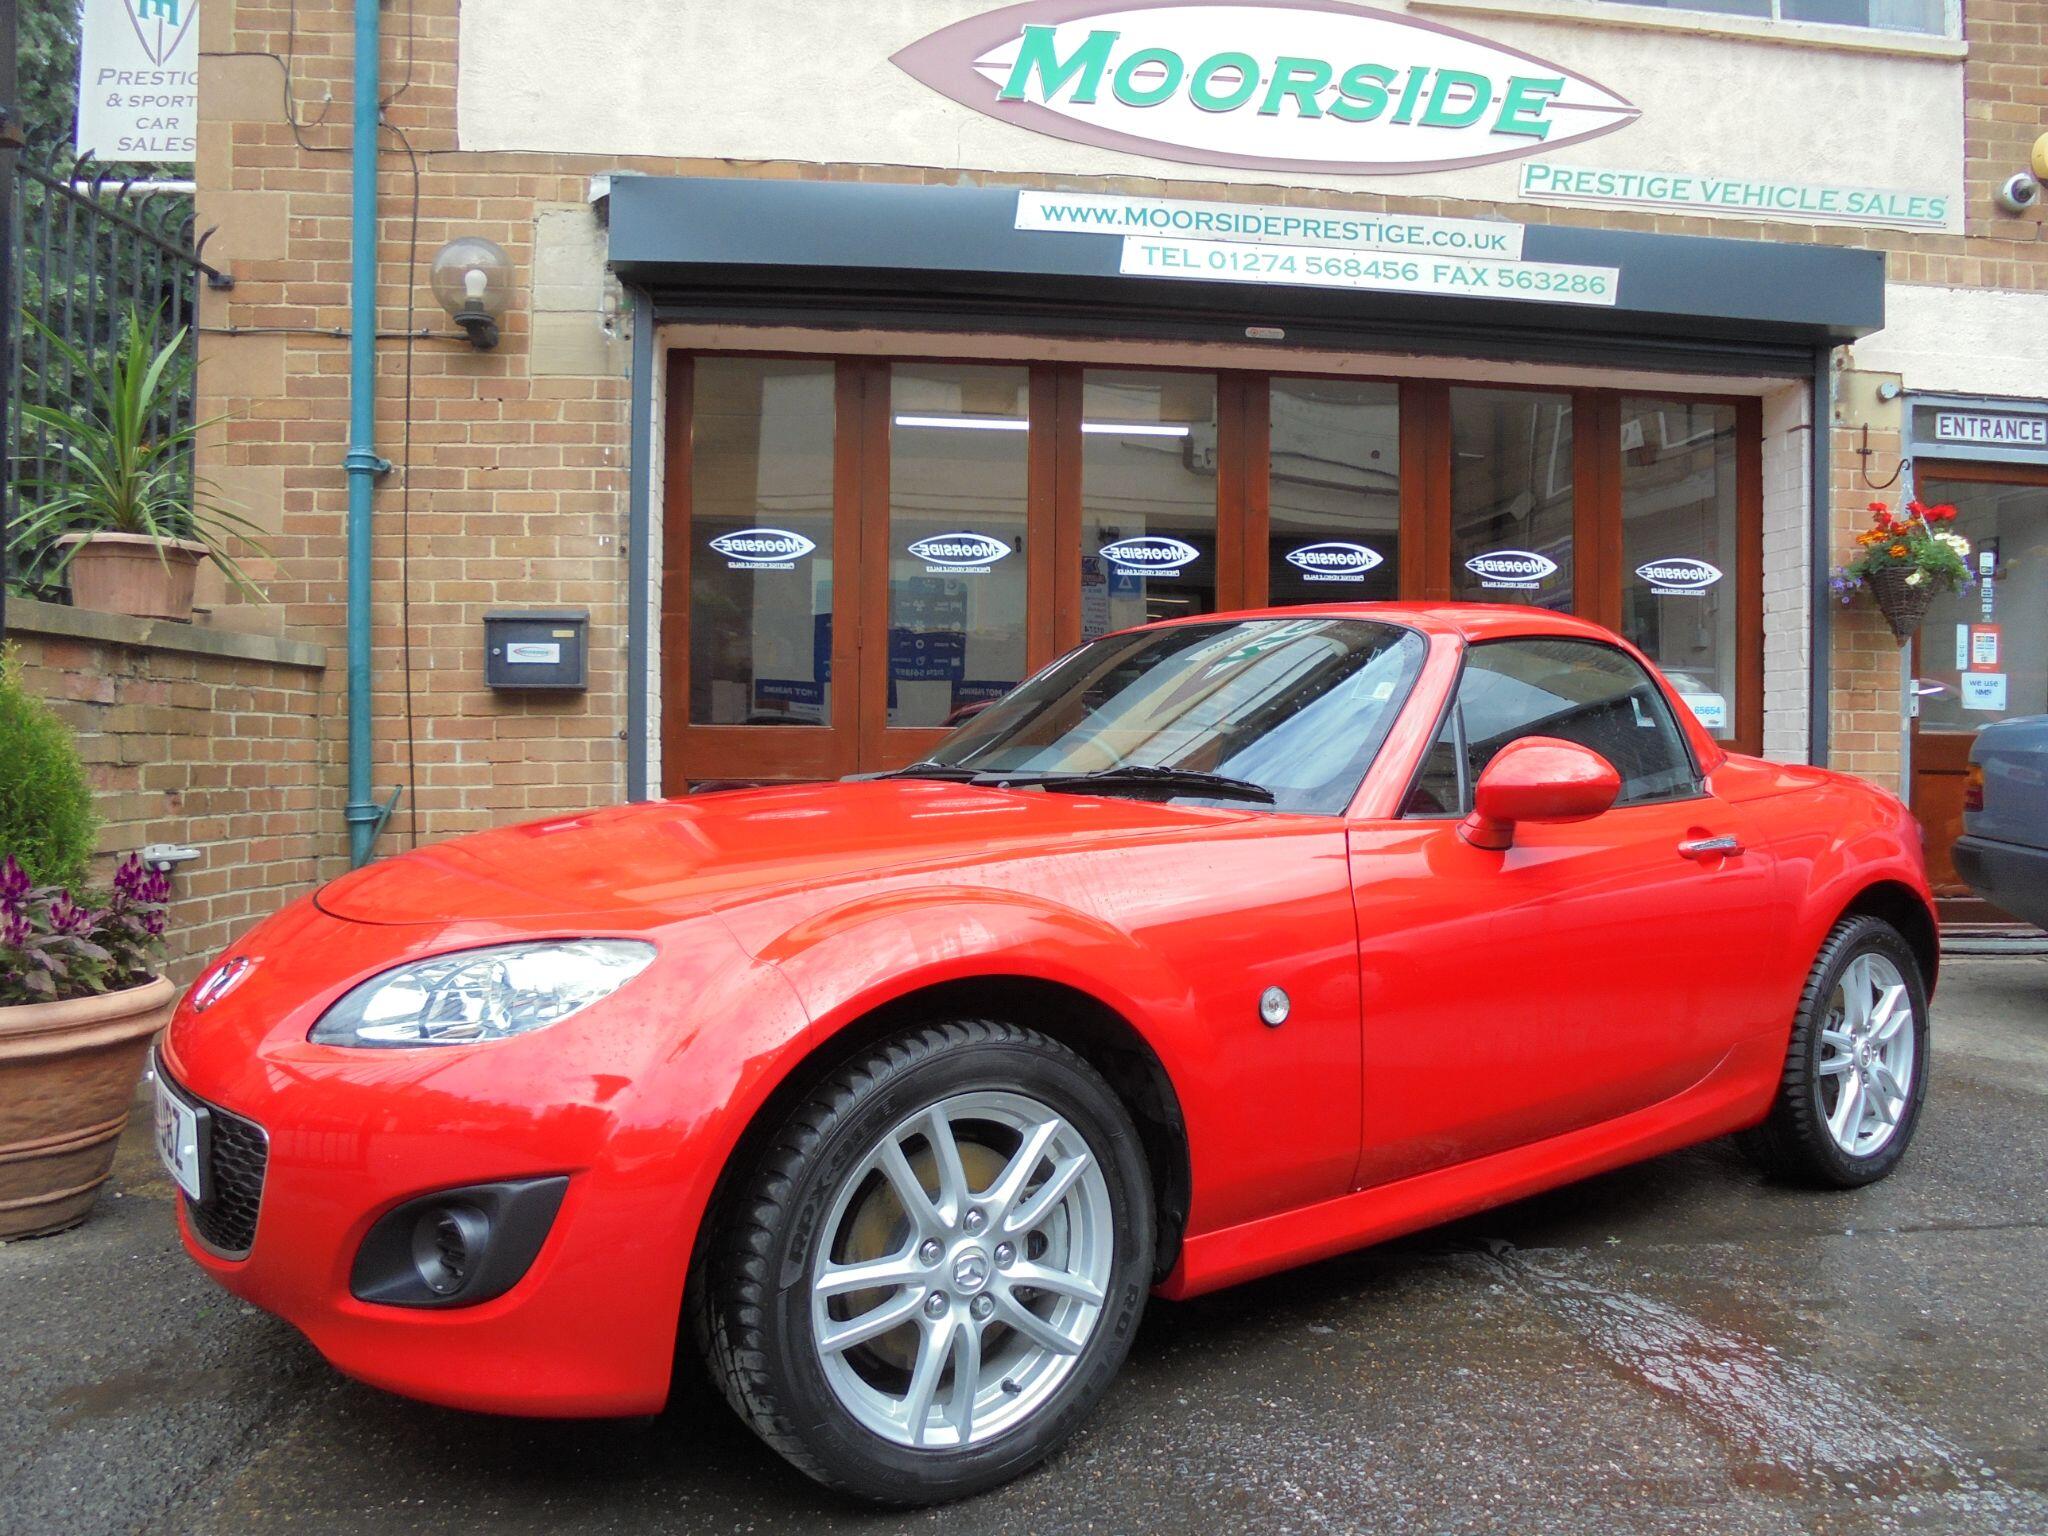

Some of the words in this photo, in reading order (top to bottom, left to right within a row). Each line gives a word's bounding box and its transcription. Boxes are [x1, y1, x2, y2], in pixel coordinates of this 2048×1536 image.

[996, 23, 1566, 141] MOORSIDE
[106, 93, 122, 108] &
[136, 117, 180, 130] CAR
[117, 137, 196, 152] SALES
[1524, 163, 1692, 201] PRESTIGE
[1700, 179, 1839, 211] VEHICLE
[1846, 191, 1947, 220] SALES
[1142, 245, 1200, 269] TEL
[1208, 250, 1298, 276] 01274
[1305, 255, 1419, 283] 568456
[1432, 263, 1489, 287] FAX
[1497, 268, 1606, 296] 563286
[1940, 416, 2043, 441] ENTRANCE
